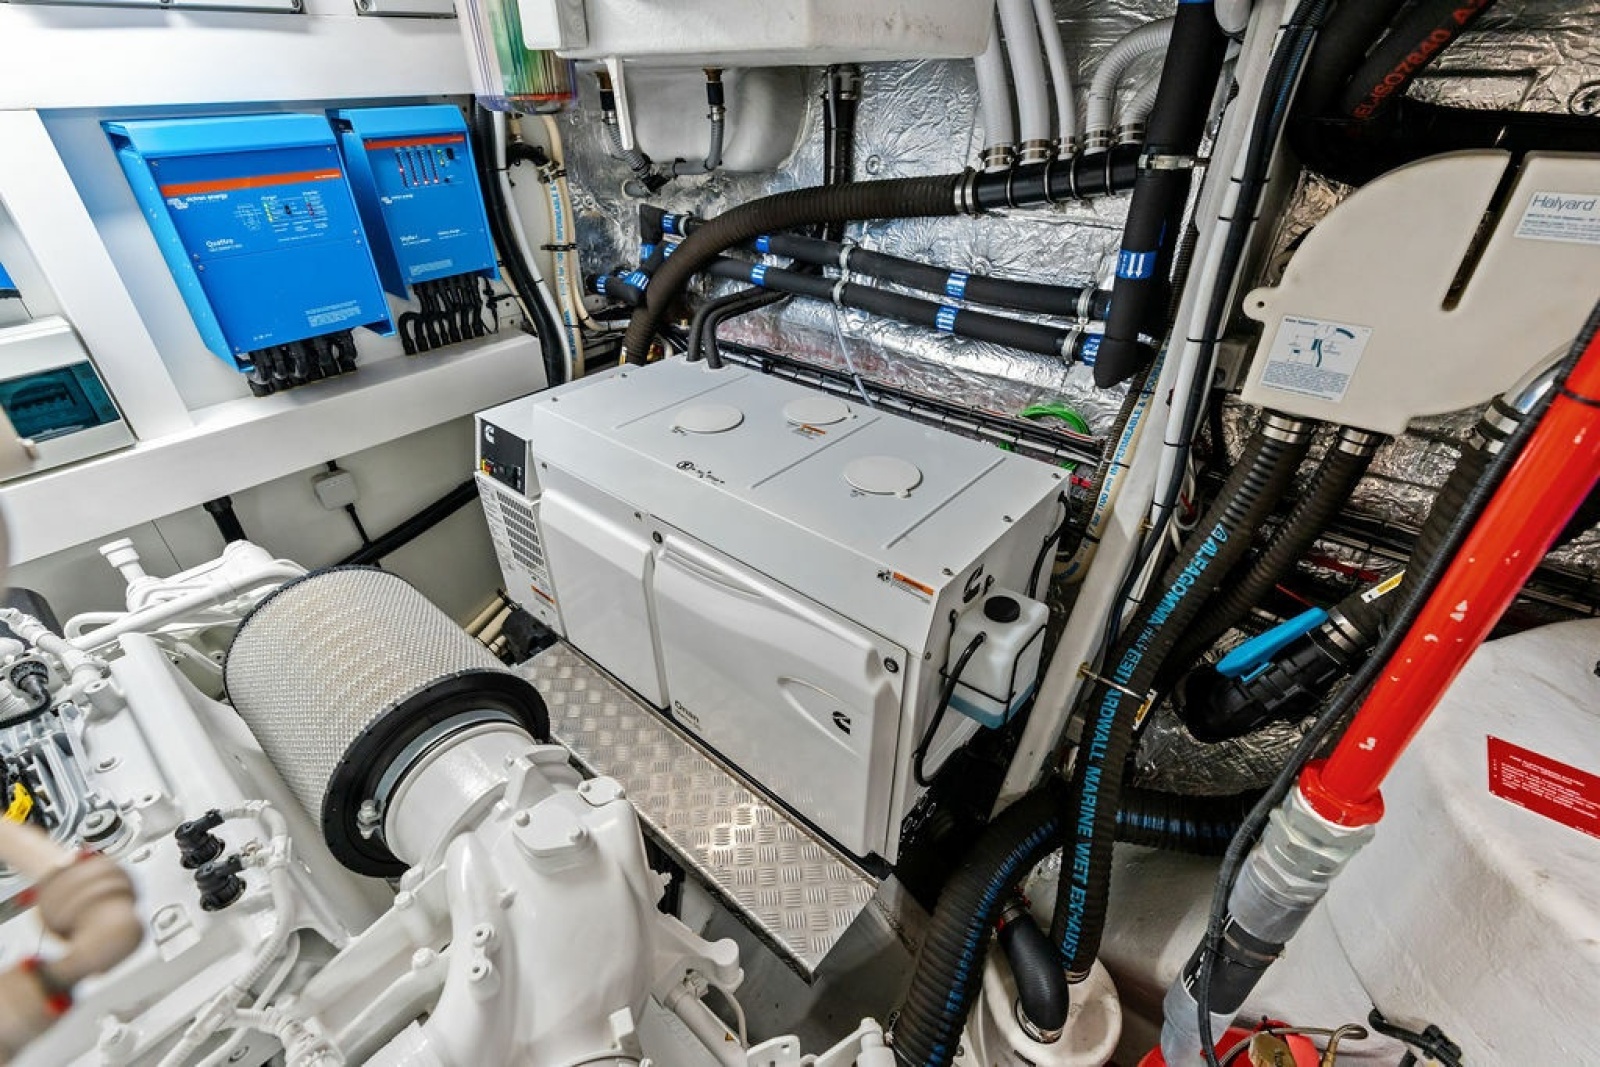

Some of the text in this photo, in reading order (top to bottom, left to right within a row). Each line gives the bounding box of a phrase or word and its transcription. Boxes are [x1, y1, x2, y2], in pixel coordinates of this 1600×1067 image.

[1532, 194, 1598, 212] Halyard
[1077, 764, 1102, 838] MARINE
[1073, 841, 1092, 885] WET
[1061, 884, 1087, 961] EXHAUST
